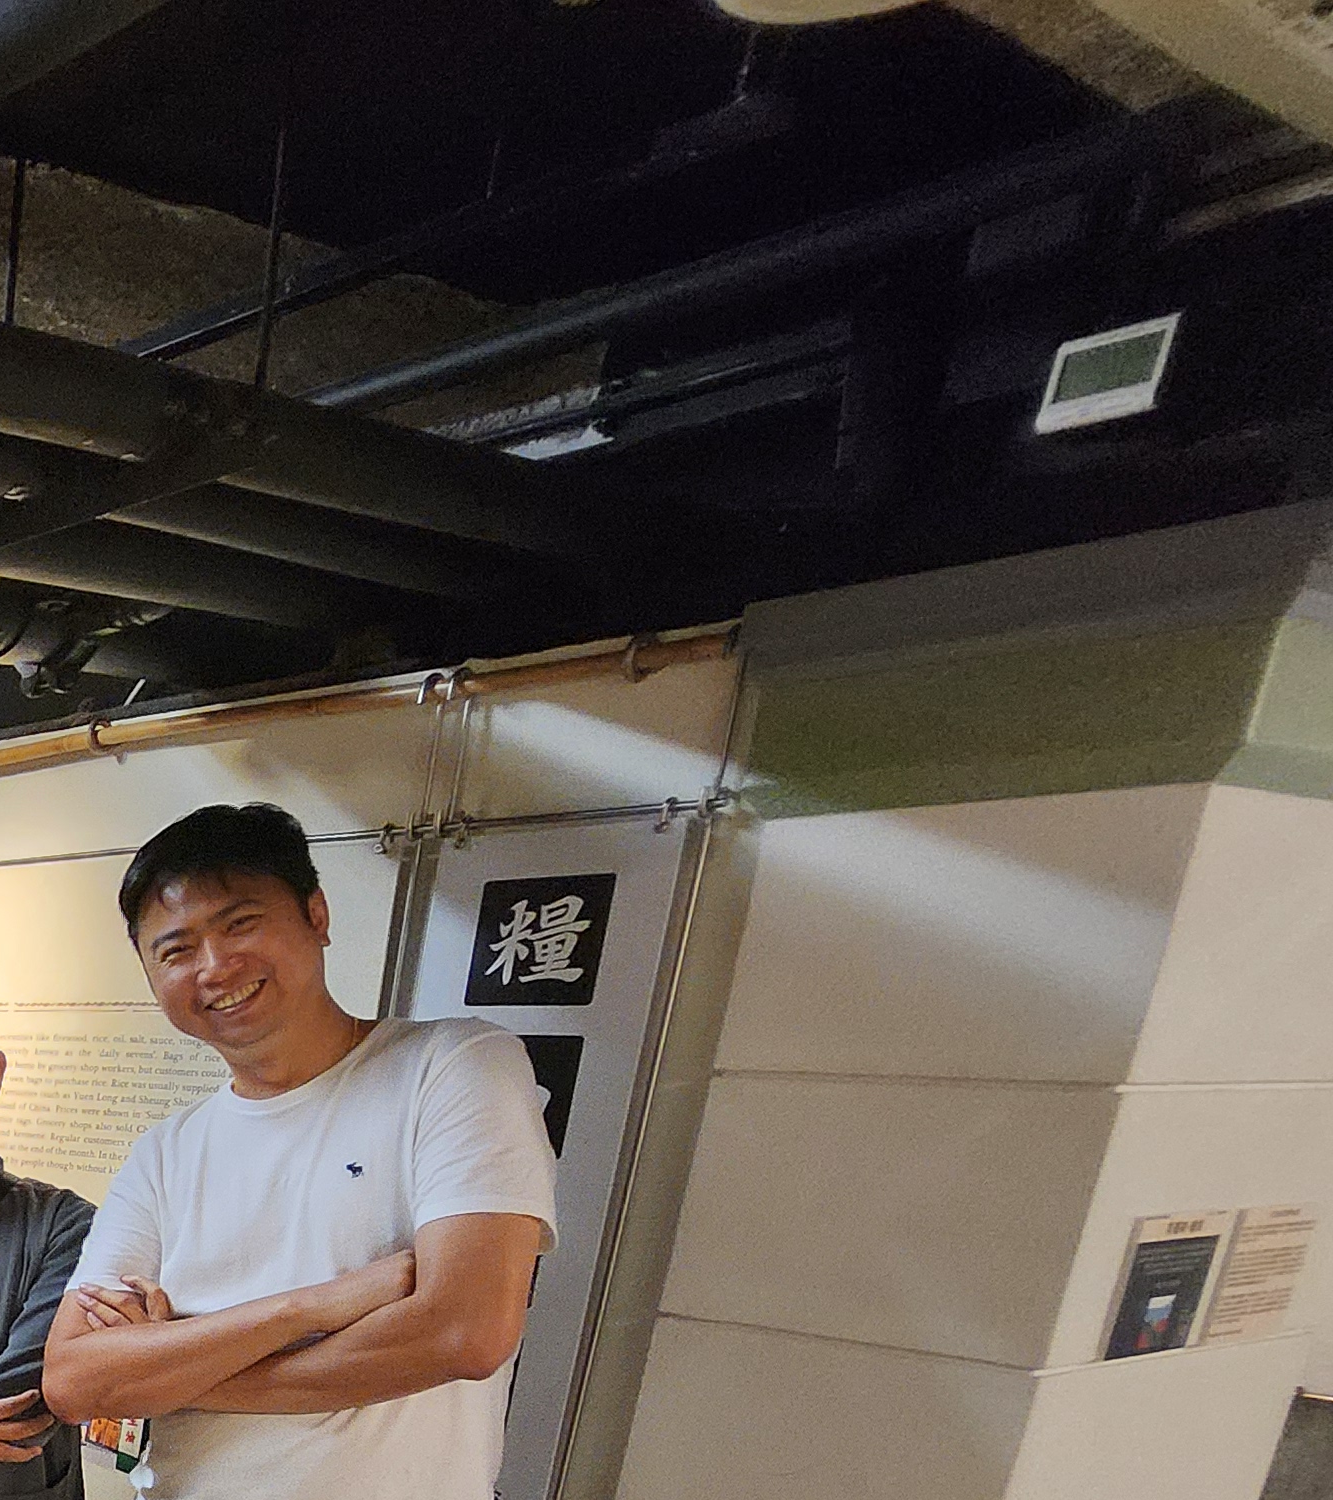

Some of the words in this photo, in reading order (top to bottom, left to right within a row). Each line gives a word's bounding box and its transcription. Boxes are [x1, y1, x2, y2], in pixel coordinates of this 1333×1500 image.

[484, 895, 591, 986] 糧
[149, 1037, 175, 1046] sauce,
[78, 1049, 92, 1057] the
[163, 1051, 183, 1063] Bags
[189, 1053, 200, 1061] of
[80, 1063, 99, 1074] shop
[101, 1066, 136, 1075] workers,
[138, 1065, 152, 1074] but
[154, 1067, 199, 1077] customers
[201, 1069, 226, 1078] could
[54, 1077, 89, 1087] purchase
[111, 1079, 130, 1088] Rice
[148, 1081, 179, 1094] usually
[182, 1084, 220, 1095] supplied
[97, 1093, 119, 1105] Long
[120, 1095, 137, 1104] and
[138, 1095, 171, 1109] Sheung
[56, 1105, 78, 1114] Prices
[81, 1108, 100, 1116] were
[102, 1108, 129, 1117] shown
[70, 1120, 92, 1132] shops
[95, 1122, 113, 1130] also
[116, 1124, 133, 1133] sold
[50, 1132, 81, 1144] Regular
[83, 1136, 125, 1146] customers
[17, 1144, 29, 1152] the
[30, 1145, 44, 1153] end
[45, 1146, 54, 1155] of
[55, 1147, 68, 1155] the
[98, 1150, 107, 1159] In
[109, 1152, 123, 1161] the
[21, 1159, 45, 1168] people
[46, 1160, 75, 1172] though
[76, 1162, 107, 1174] without
